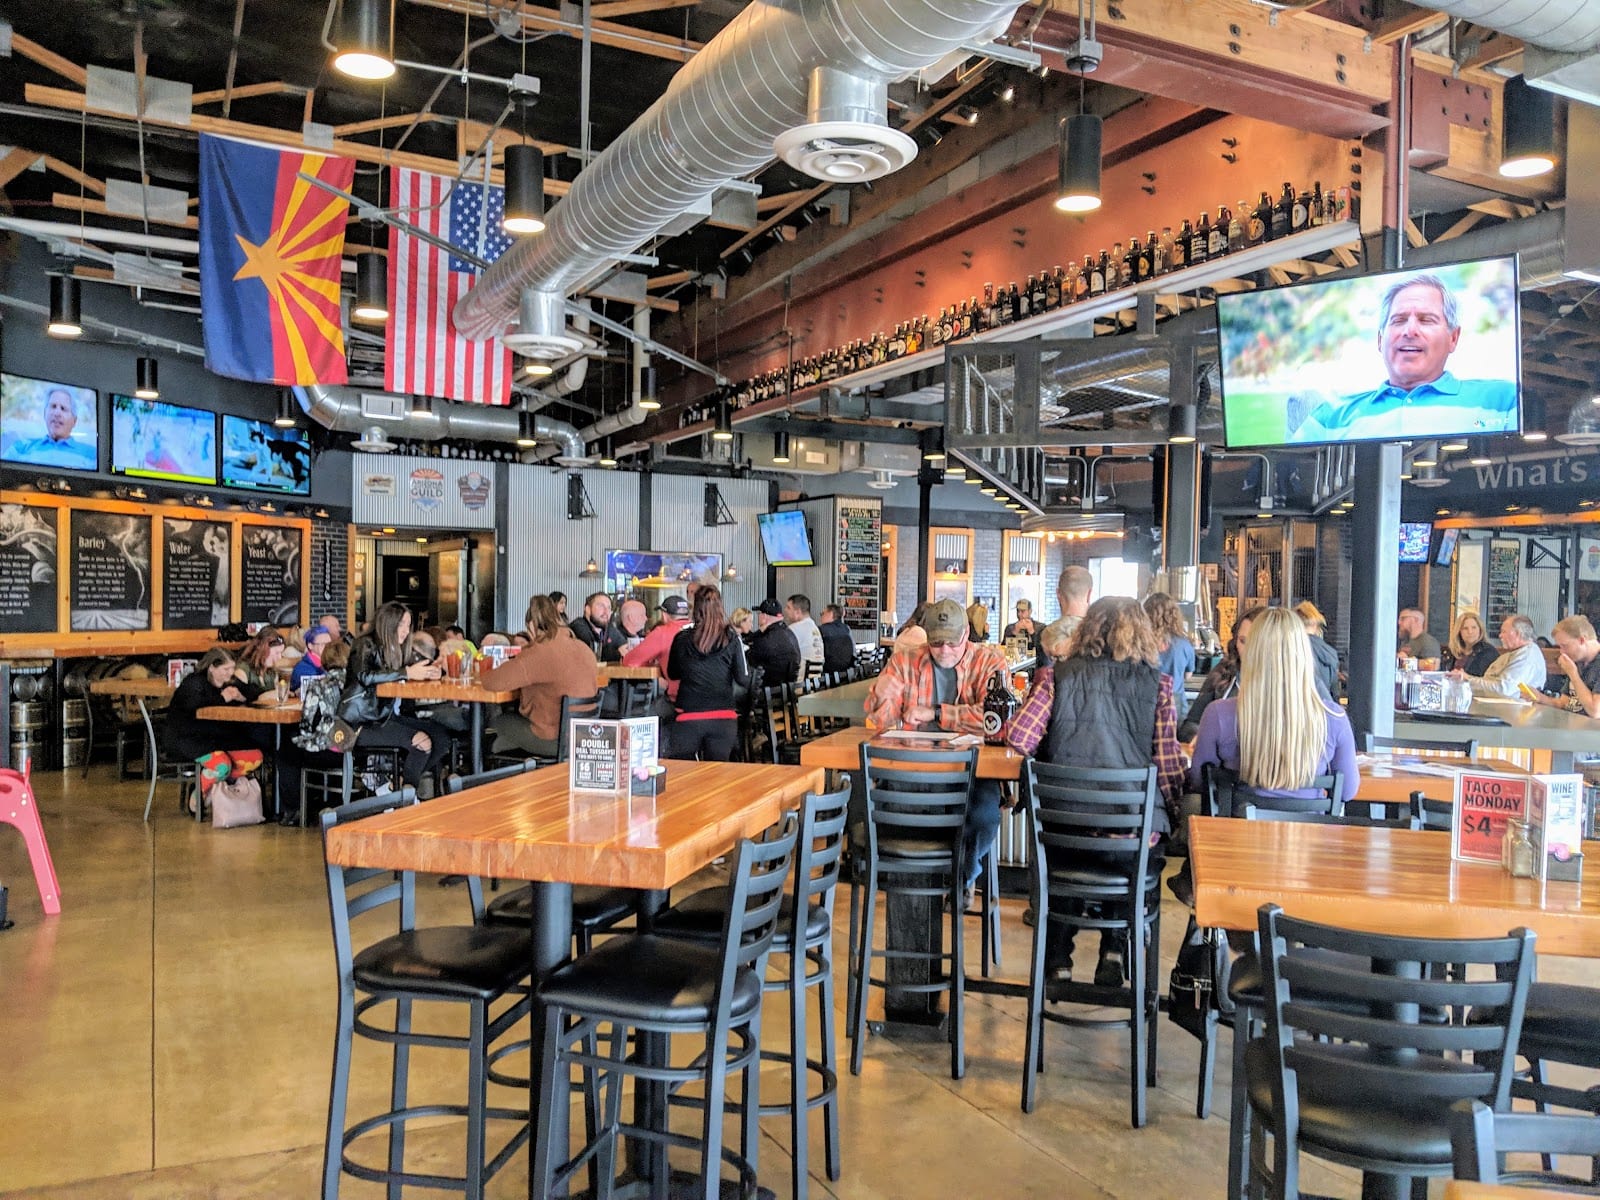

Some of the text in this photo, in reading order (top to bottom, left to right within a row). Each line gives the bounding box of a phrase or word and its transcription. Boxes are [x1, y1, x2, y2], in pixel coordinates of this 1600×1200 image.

[1476, 457, 1588, 490] What's
[411, 479, 443, 487] ARIZONA
[411, 487, 443, 497] GUILD
[79, 536, 106, 550] Barley
[169, 541, 192, 555] Water
[248, 545, 266, 559] Yeast
[637, 723, 651, 733] WINE
[581, 739, 610, 748] DOUBLE
[589, 748, 616, 756] TUESDAYS!
[579, 762, 590, 772] $6
[1466, 781, 1501, 795] TACO
[1552, 782, 1573, 794] WINE
[1465, 794, 1521, 811] MONDAY
[1464, 814, 1492, 837] $4
